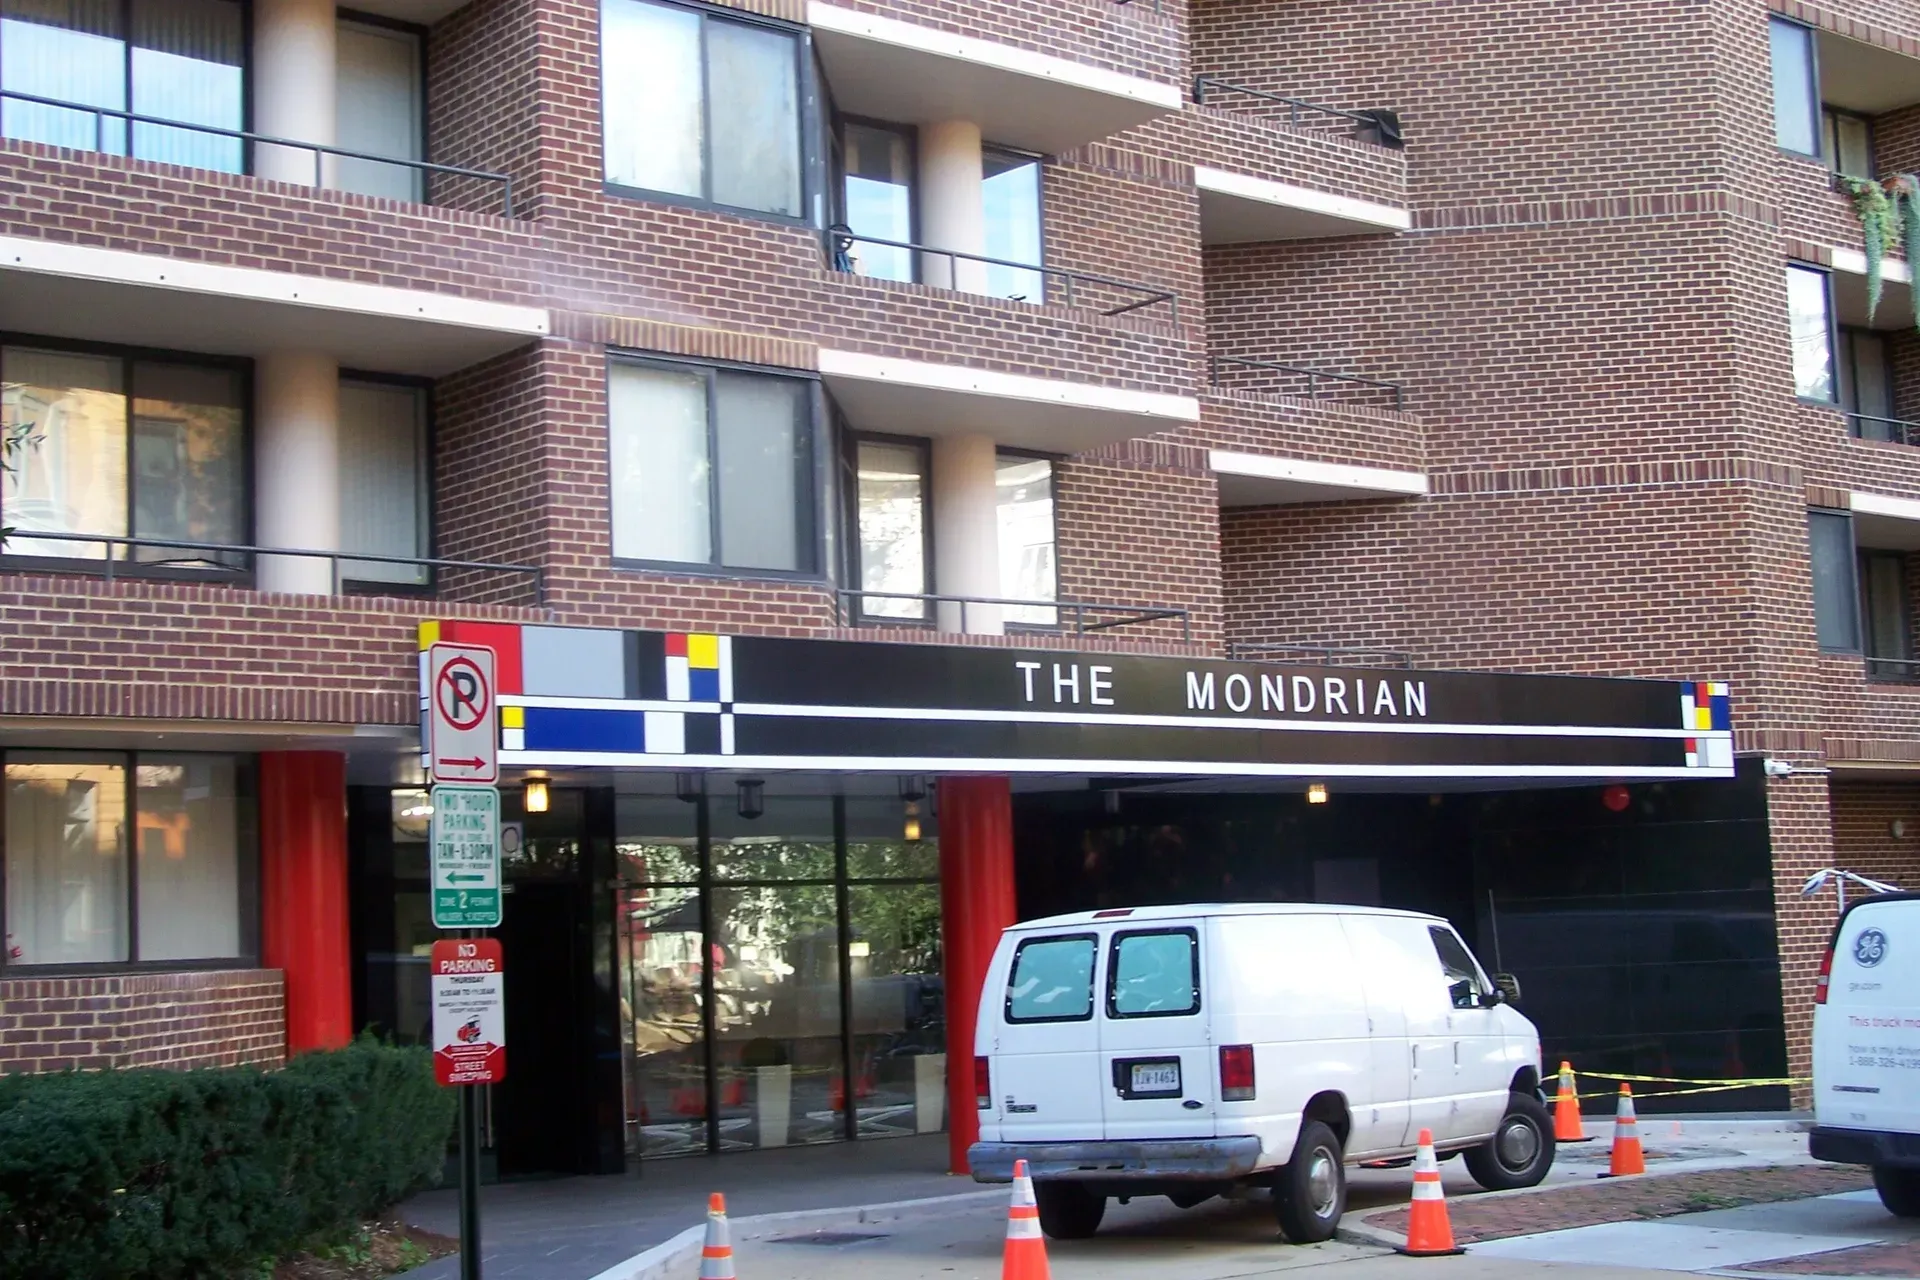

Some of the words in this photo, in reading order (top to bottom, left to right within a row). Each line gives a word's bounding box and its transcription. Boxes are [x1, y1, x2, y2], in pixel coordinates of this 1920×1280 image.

[453, 671, 477, 718] P
[1015, 661, 1115, 706] THE
[1185, 671, 1427, 717] MONDRIAN
[438, 793, 458, 810] TWO
[465, 794, 492, 811] HOUR
[443, 813, 486, 831] PARKING
[459, 891, 468, 909] 2
[458, 944, 477, 957] NO
[440, 958, 496, 973] PARKING
[449, 976, 485, 984] THURSDAY
[1848, 1015, 1869, 1027] This
[1872, 1017, 1901, 1028] truck
[454, 1061, 486, 1072] STREET
[449, 1071, 492, 1082] SWEEPING
